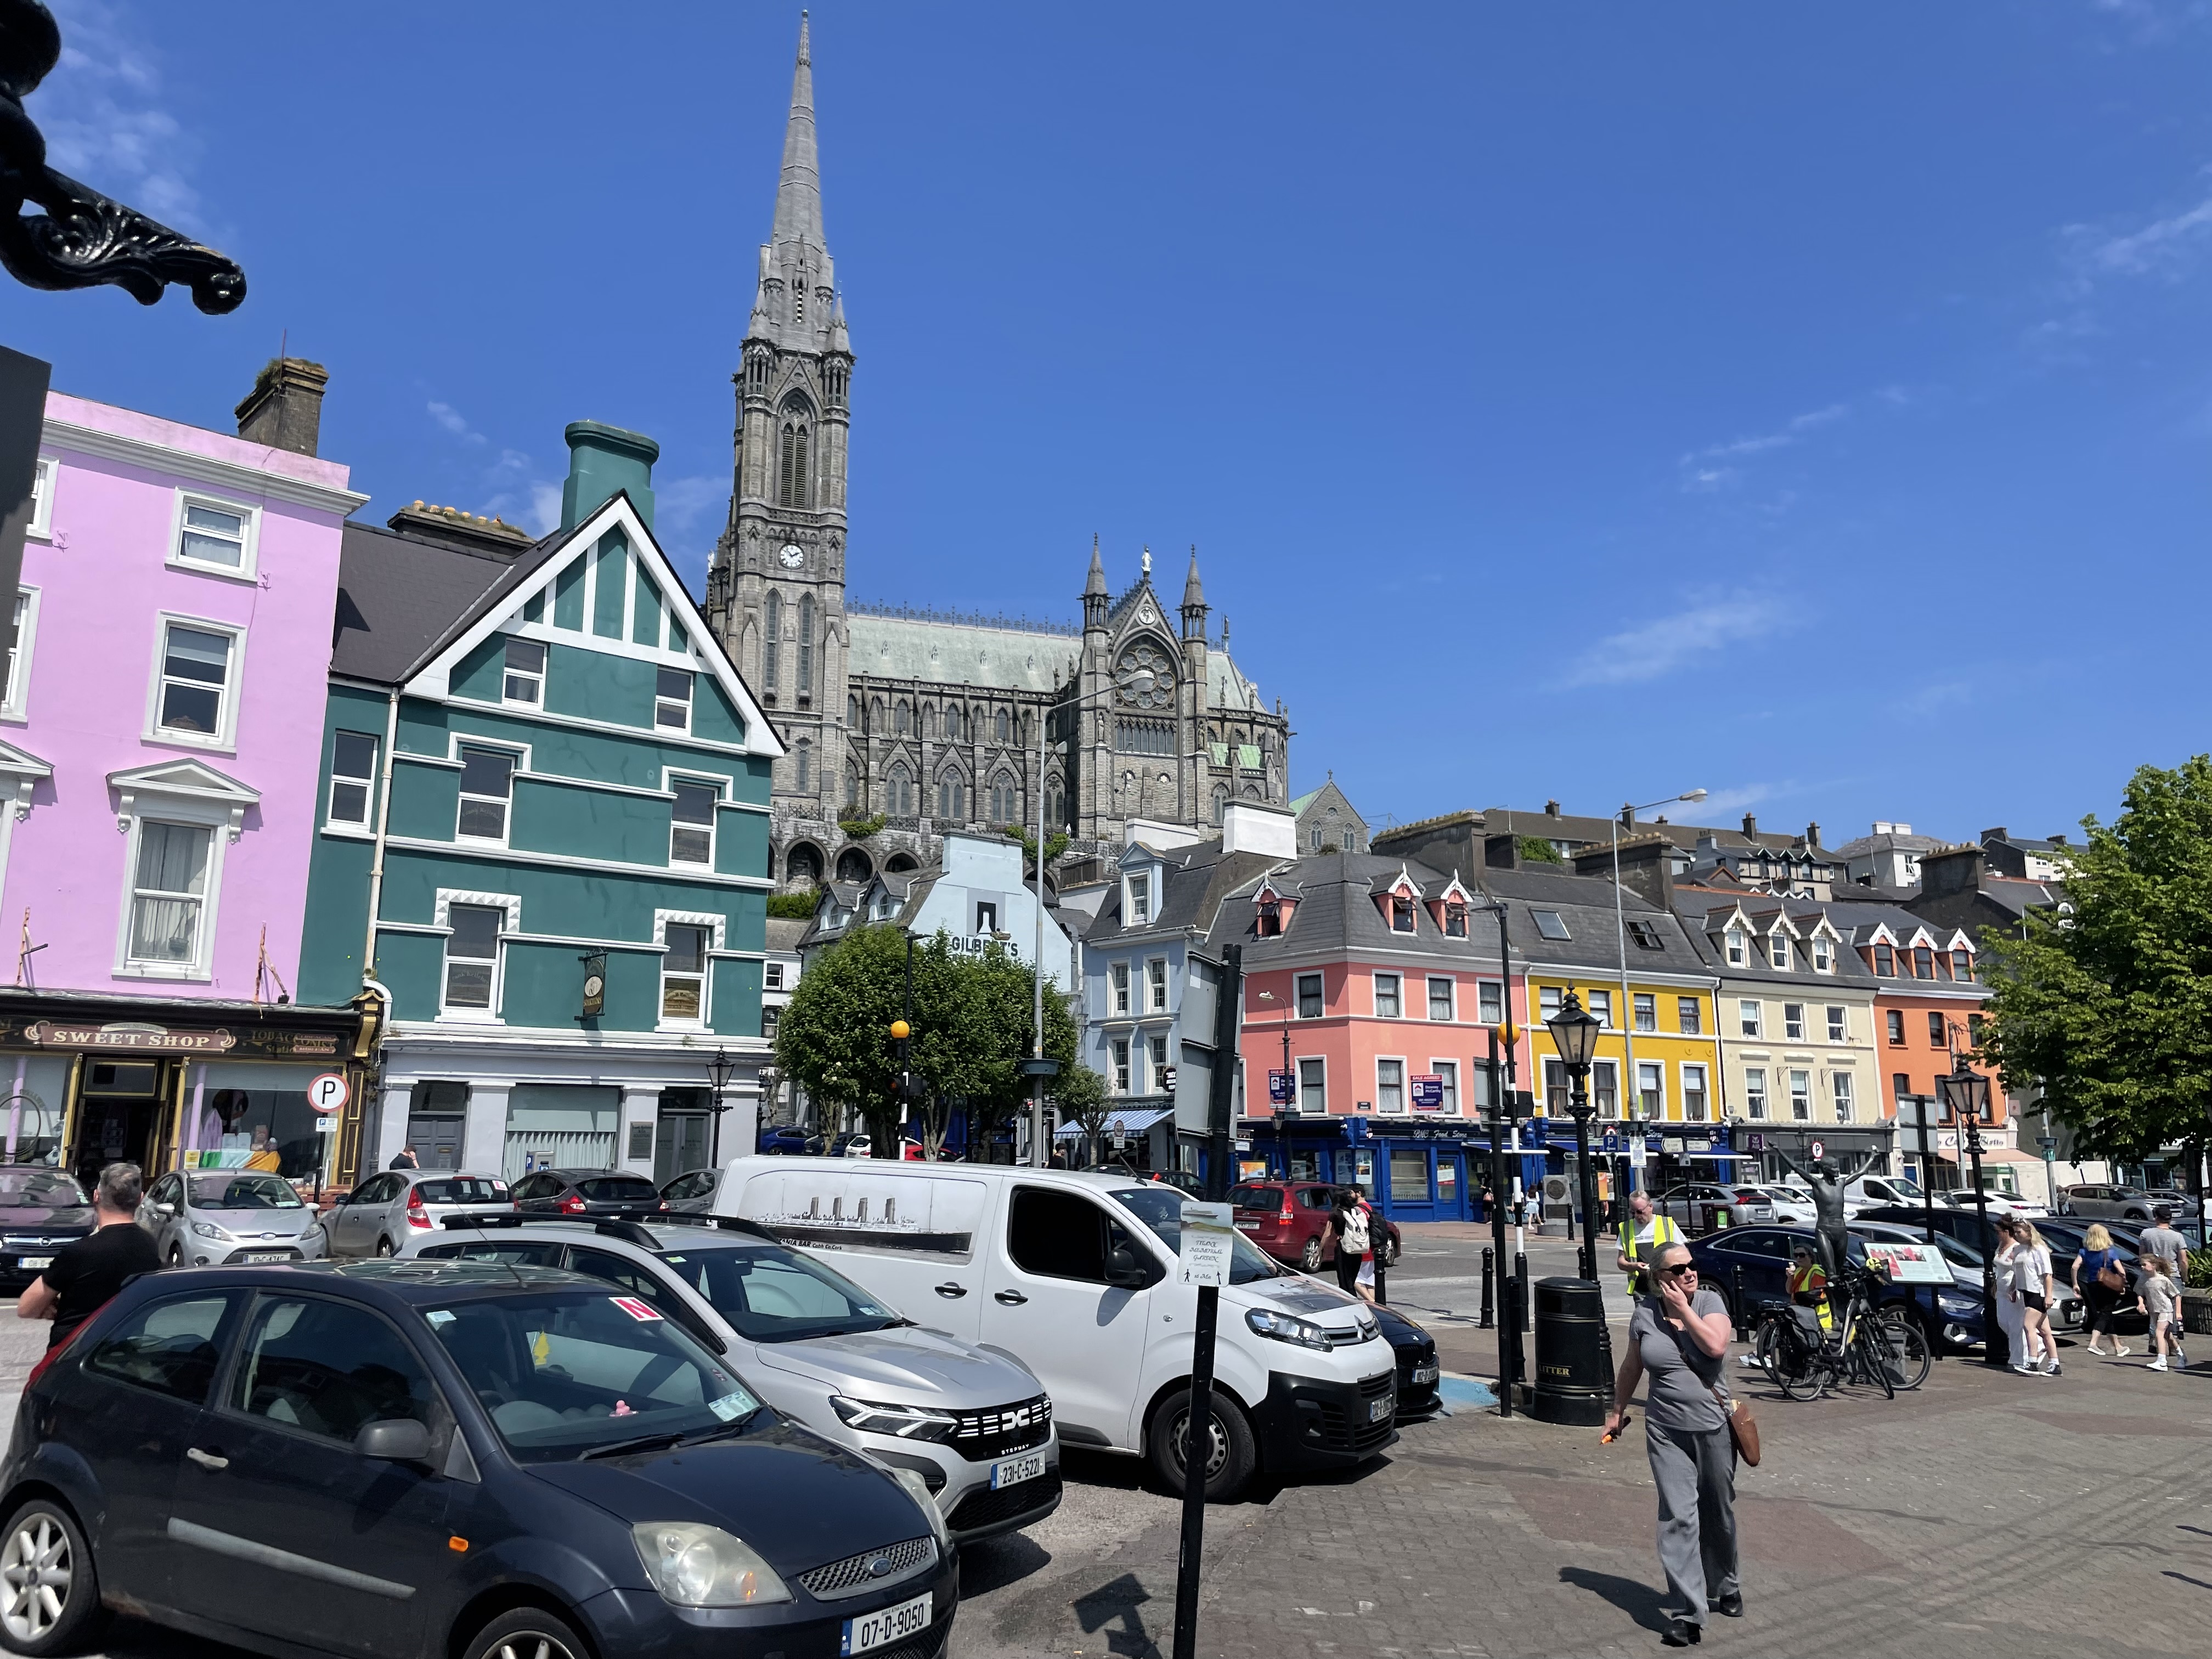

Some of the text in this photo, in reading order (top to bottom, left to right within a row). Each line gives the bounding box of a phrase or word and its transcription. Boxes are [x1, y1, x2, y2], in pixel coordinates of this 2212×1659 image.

[952, 936, 1018, 957] GILBET'S
[53, 1031, 210, 1047] SWEET SHOP
[321, 1080, 336, 1104] P
[1607, 1137, 1613, 1146] P
[1815, 1144, 1820, 1155] P
[494, 1180, 506, 1189] L
[614, 1298, 660, 1319] N
[1538, 1364, 1570, 1376] LITTER
[1001, 1443, 1030, 1455] STEPWAY
[1002, 1457, 1040, 1484] 231-C-5221
[861, 1602, 924, 1647] 07-D-9050
